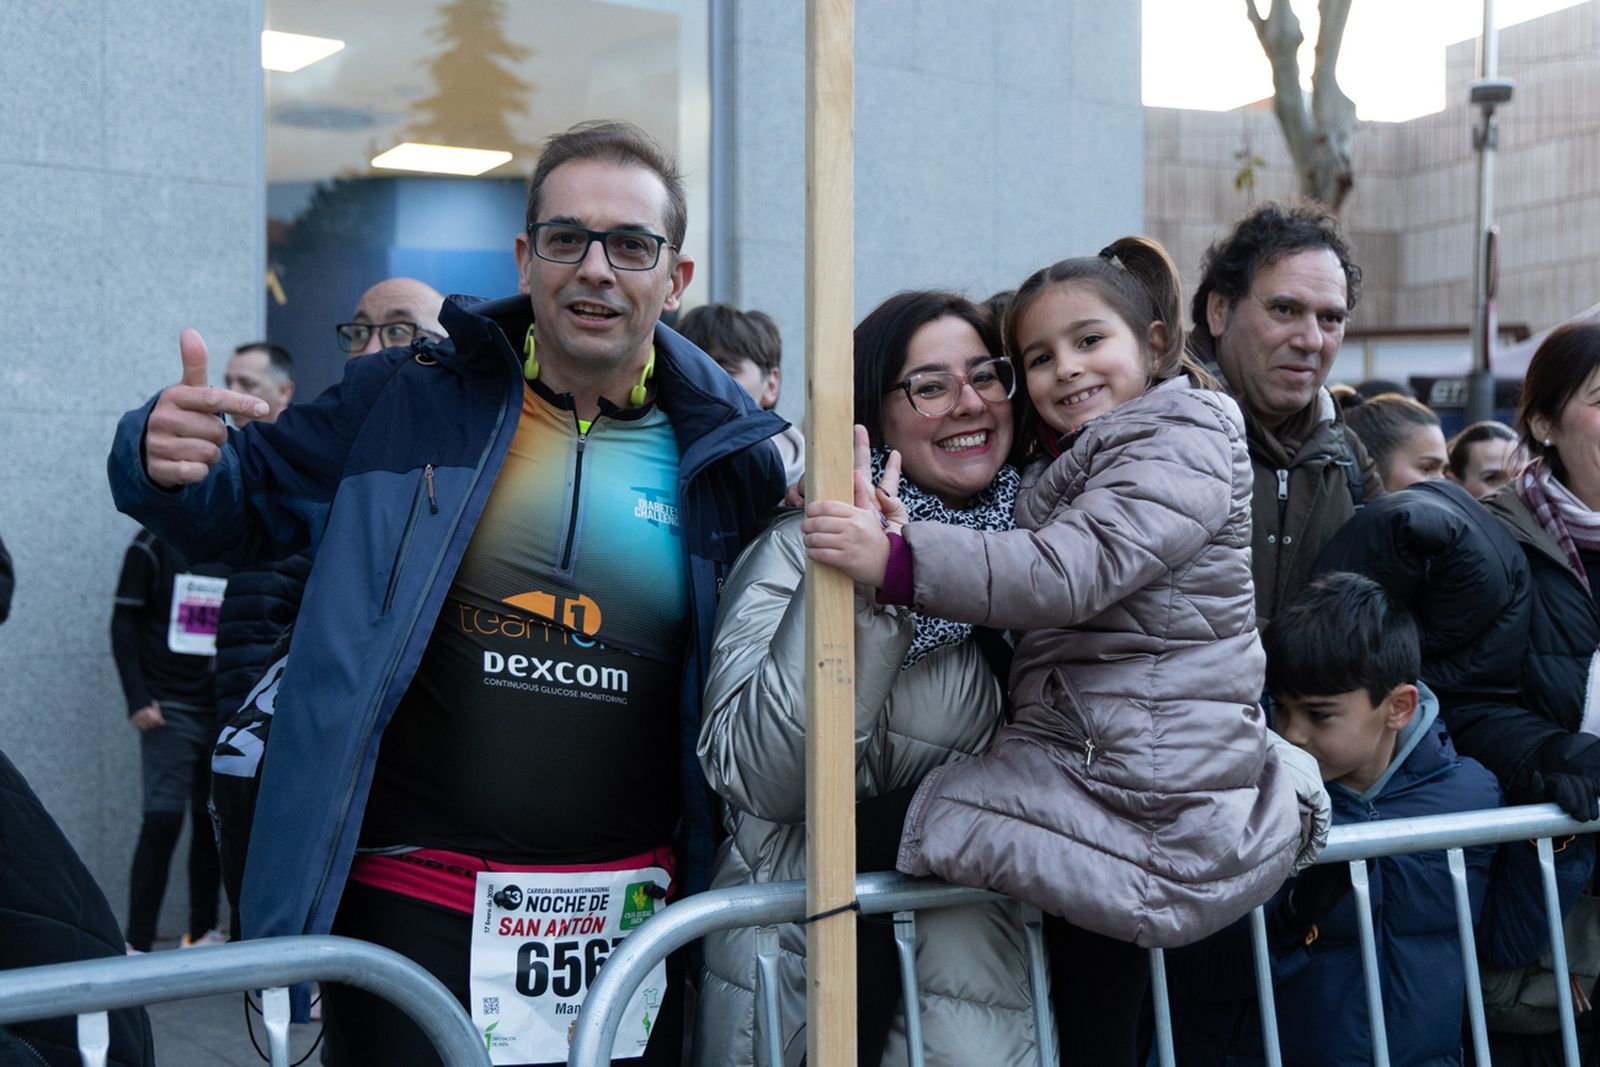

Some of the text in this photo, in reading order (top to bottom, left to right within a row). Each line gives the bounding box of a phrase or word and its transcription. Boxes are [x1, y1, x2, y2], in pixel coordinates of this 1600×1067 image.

[483, 677, 629, 705] CONTINUOUS GLUCOSE MONITORING
[525, 893, 610, 913] NOCHE DE
[526, 886, 610, 895] CARRERA URBANA INTERNACIONAL
[498, 912, 606, 938] SAN ANTÓN
[515, 938, 625, 997] 656
